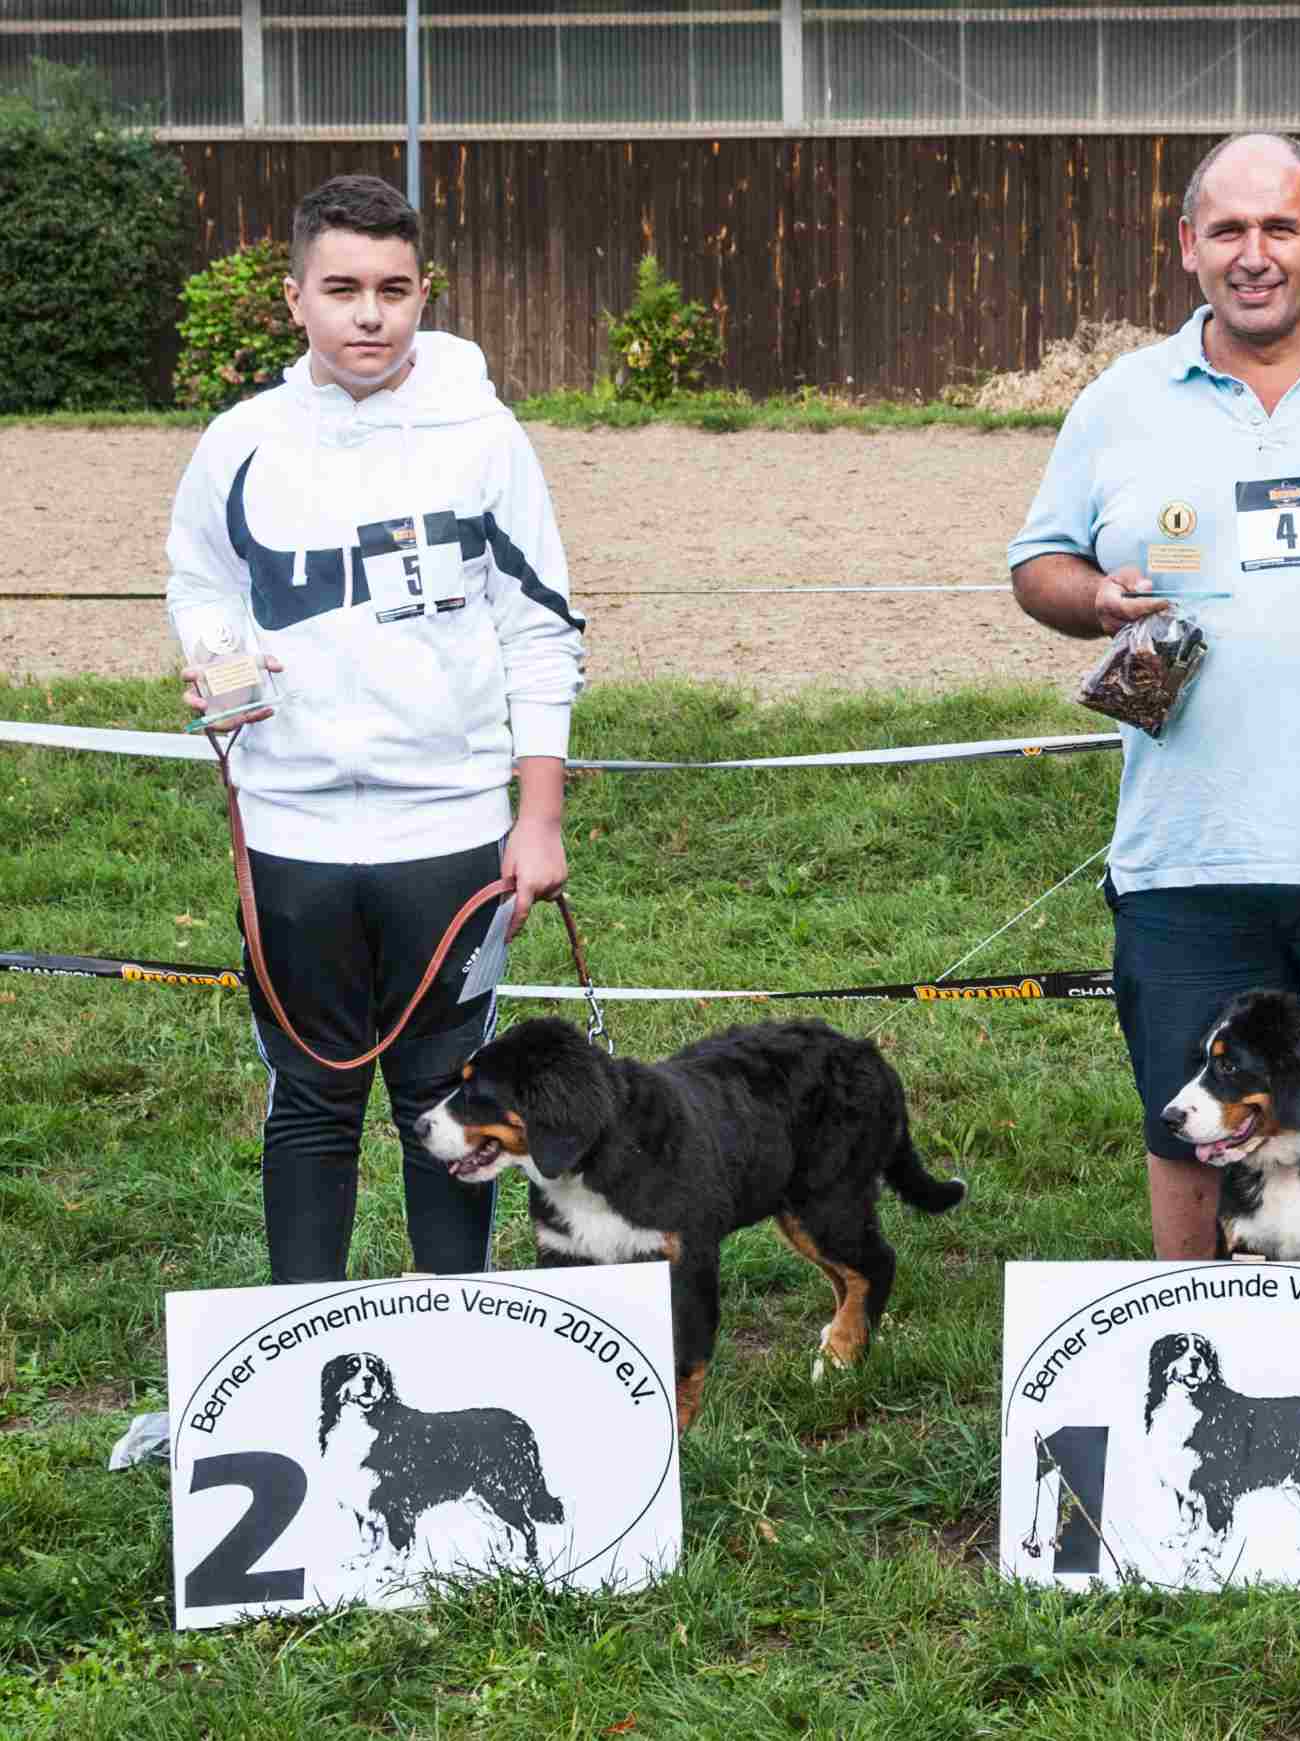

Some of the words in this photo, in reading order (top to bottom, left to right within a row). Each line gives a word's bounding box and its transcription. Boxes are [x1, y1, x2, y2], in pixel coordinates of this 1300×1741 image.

[402, 555, 423, 596] 5
[1276, 513, 1298, 549] 4
[190, 1354, 256, 1434] Berner
[258, 1288, 450, 1361] Sennenhunde
[461, 1288, 548, 1328] Verein
[553, 1312, 621, 1363] 2010
[615, 1361, 656, 1406] e.V.
[1021, 1327, 1087, 1403] Berner
[1090, 1273, 1279, 1336] Sennenhunde
[184, 1451, 307, 1608] 2
[1036, 1425, 1110, 1574] 1
